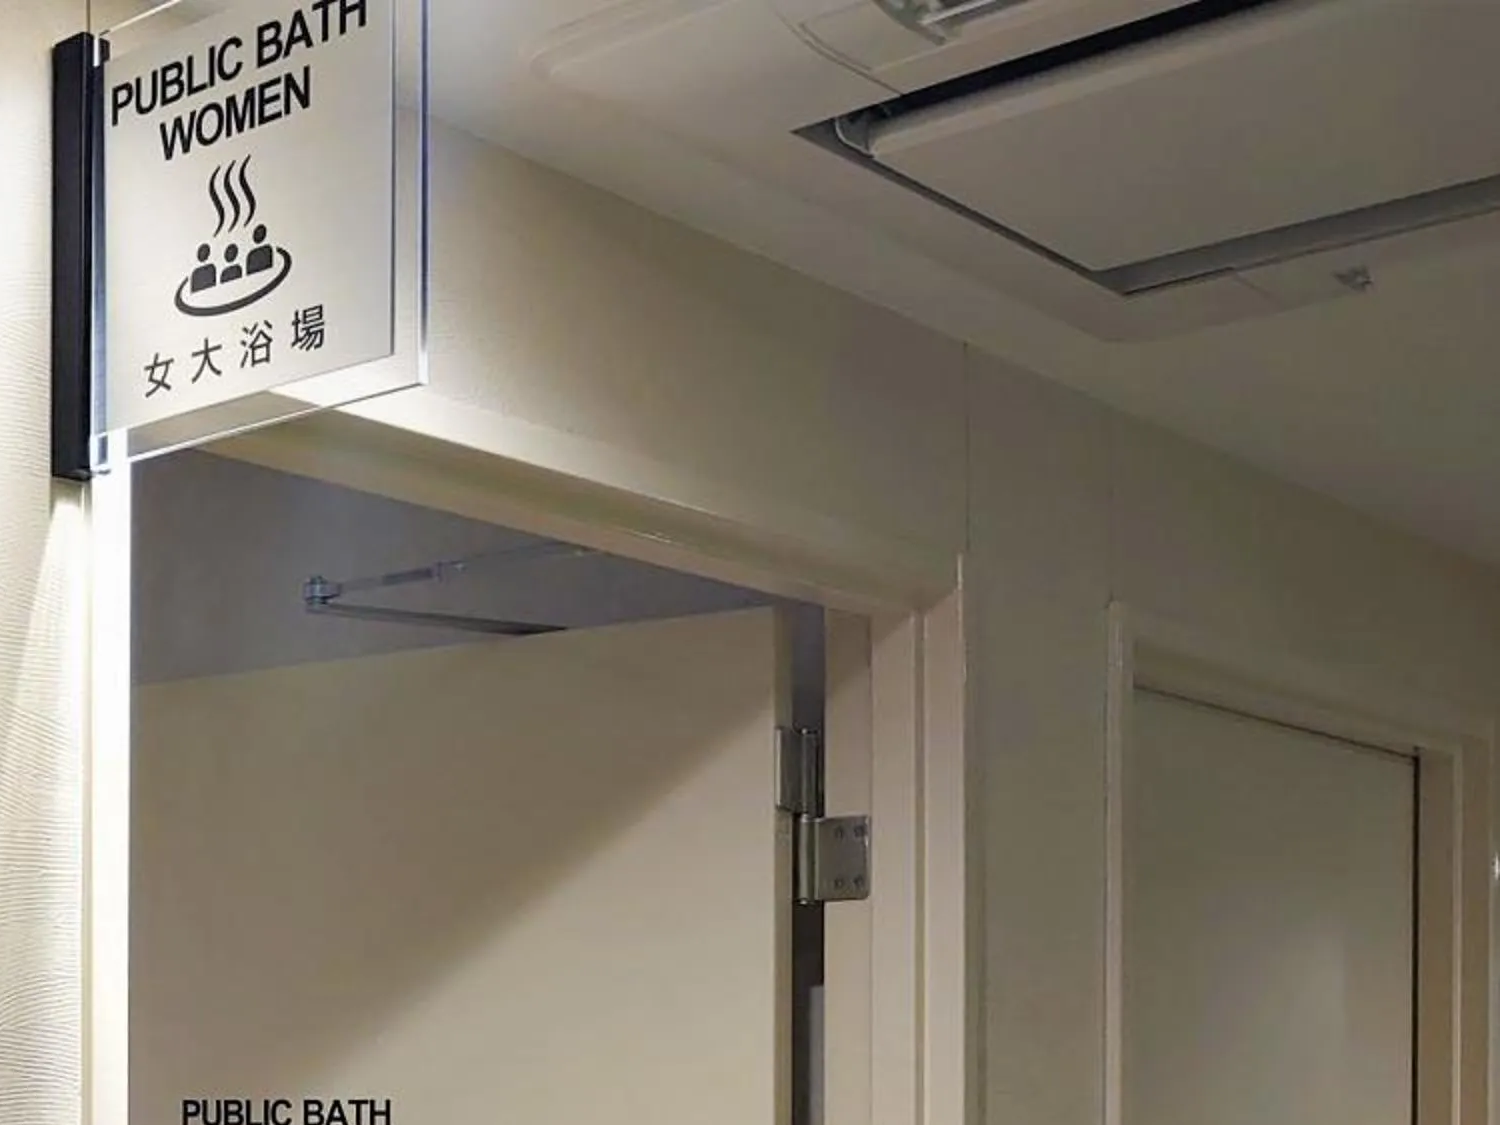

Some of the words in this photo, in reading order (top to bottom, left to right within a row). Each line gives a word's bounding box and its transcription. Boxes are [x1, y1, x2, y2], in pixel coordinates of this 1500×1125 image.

[111, 37, 243, 126] PUBLIC
[257, 0, 367, 69] BATH
[160, 66, 311, 160] WOMEN
[144, 304, 325, 398] 女大浴場
